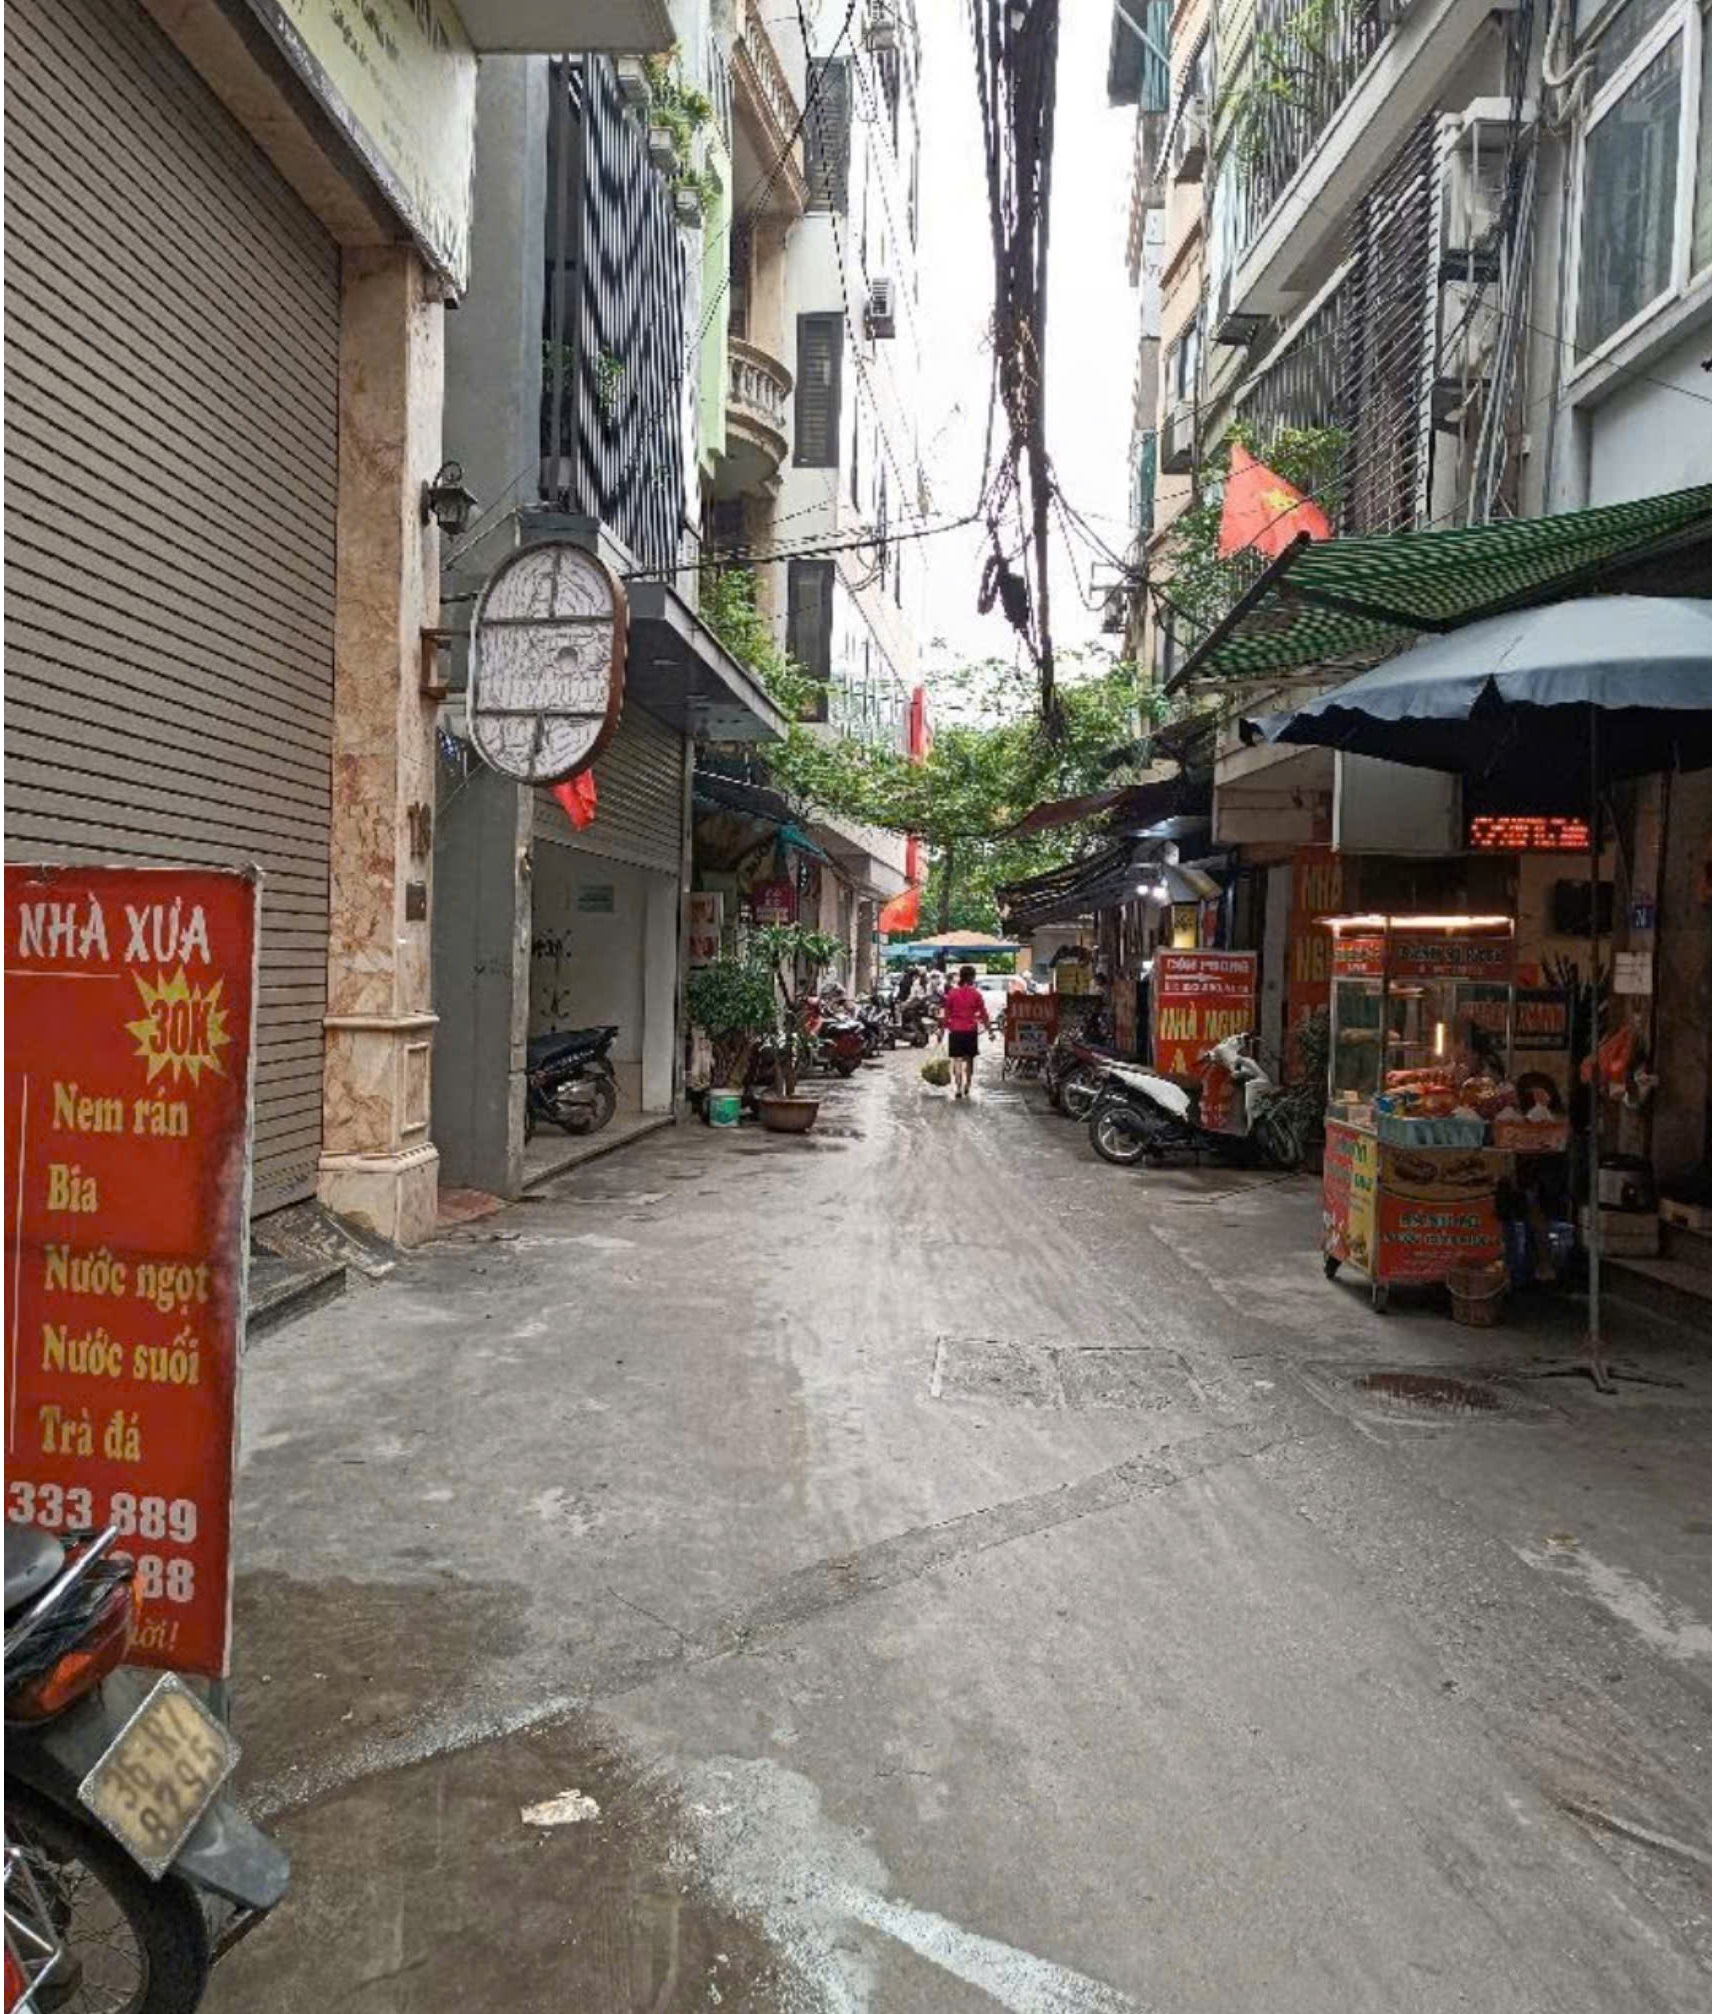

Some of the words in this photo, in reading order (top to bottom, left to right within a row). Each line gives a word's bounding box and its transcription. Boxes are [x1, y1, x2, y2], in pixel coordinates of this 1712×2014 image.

[19, 892, 110, 962] NHÀ
[124, 896, 211, 964] XƯA
[150, 998, 212, 1056] 30K
[52, 1081, 124, 1133] Nem
[132, 1085, 189, 1137] rán
[43, 1244, 126, 1296] Nước
[135, 1261, 209, 1315] ngọt
[41, 1323, 124, 1378] Nước
[133, 1325, 201, 1386] suối
[39, 1404, 93, 1456] Trà
[103, 1408, 142, 1463] đá
[7, 1480, 93, 1529] 333
[109, 1491, 197, 1544] 889
